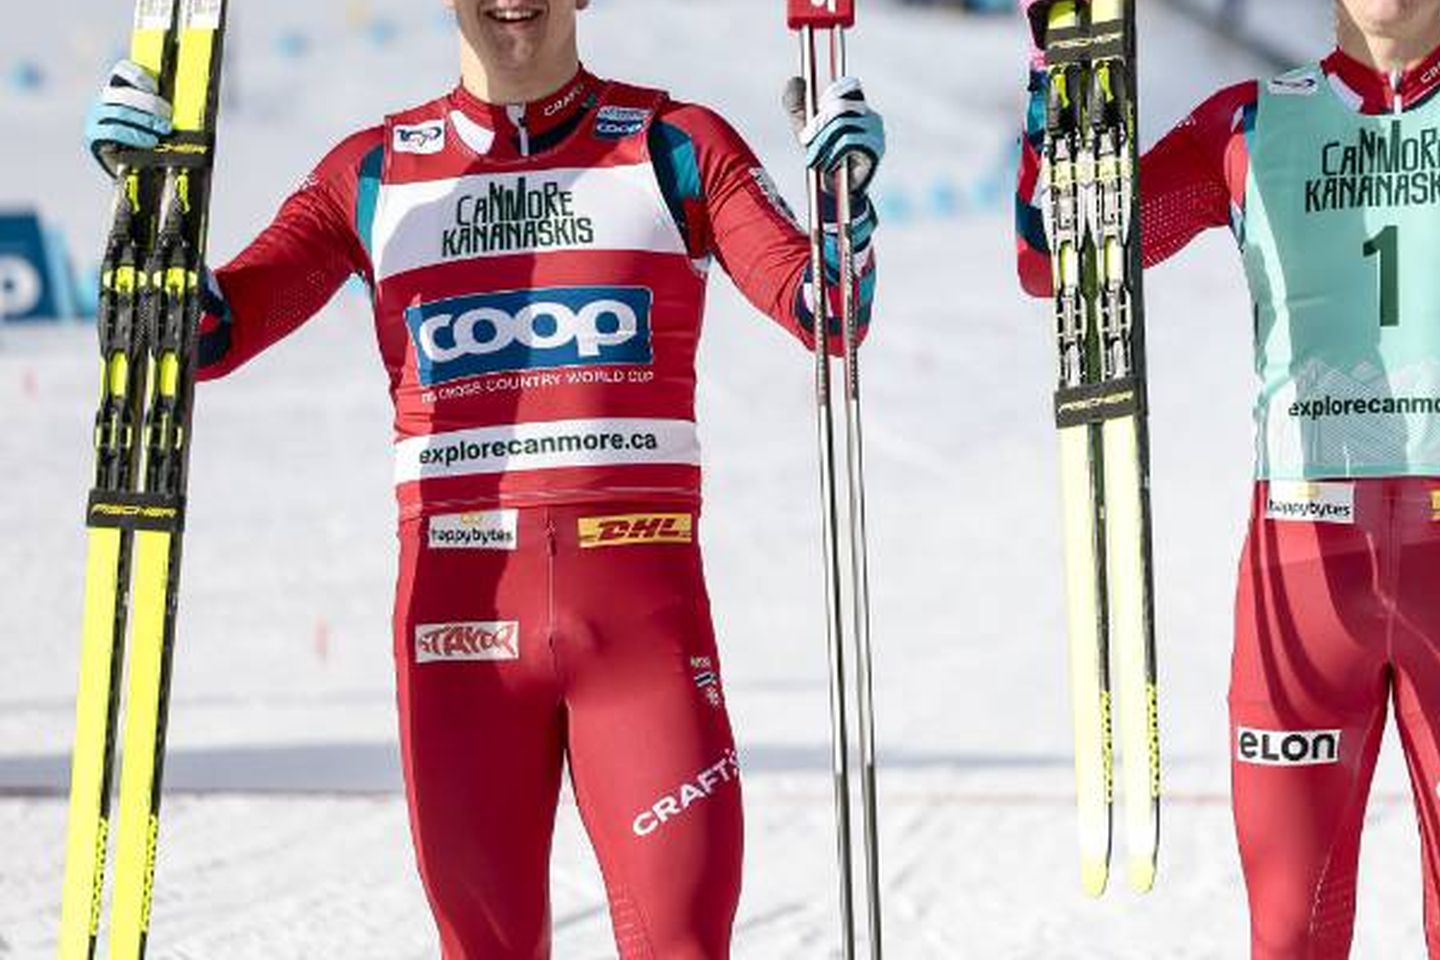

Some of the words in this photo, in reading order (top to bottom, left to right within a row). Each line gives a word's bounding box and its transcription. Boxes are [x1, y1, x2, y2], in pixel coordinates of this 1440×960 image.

[441, 217, 594, 257] KANANASKIS
[1363, 225, 1399, 327] 1
[418, 298, 638, 363] coop
[419, 431, 658, 467] explorecanmore.ca
[597, 518, 682, 541] DHL
[631, 757, 730, 837] CRAFT
